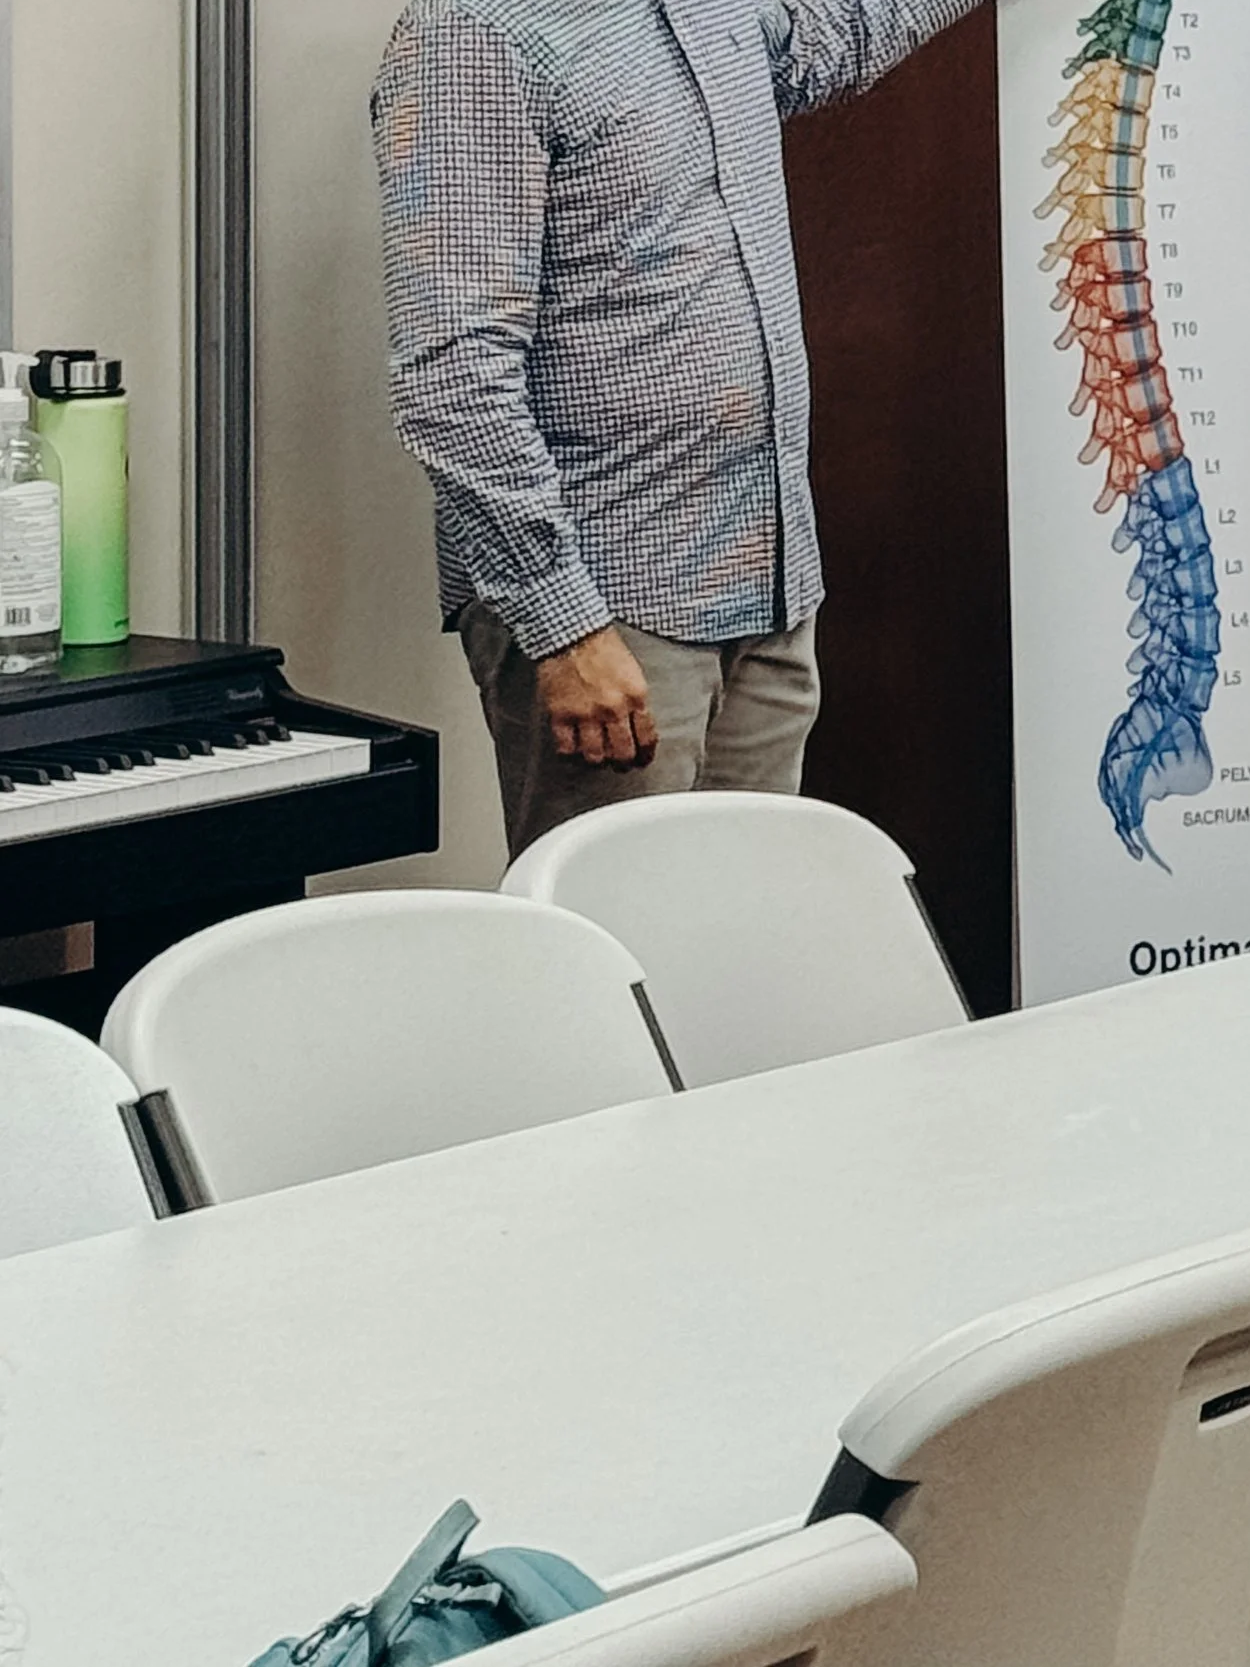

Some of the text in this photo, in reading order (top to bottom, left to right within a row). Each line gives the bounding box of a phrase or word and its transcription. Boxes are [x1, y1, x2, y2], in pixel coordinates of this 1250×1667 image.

[1180, 13, 1199, 28] T2
[1172, 46, 1191, 61] T3
[1162, 84, 1181, 99] T4
[1160, 124, 1178, 140] T5
[1157, 164, 1177, 179] T6
[1158, 204, 1177, 219] T7
[1160, 243, 1178, 259] T8
[1164, 283, 1183, 298] T9
[1172, 321, 1198, 337] T10
[1178, 367, 1203, 382] T11
[1190, 411, 1216, 426] T12
[1205, 459, 1220, 474] L1
[1219, 509, 1237, 524] L2
[1225, 559, 1243, 575] L3
[1231, 612, 1249, 627] L4
[1224, 671, 1241, 686] L5
[1183, 808, 1250, 826] SACRUM
